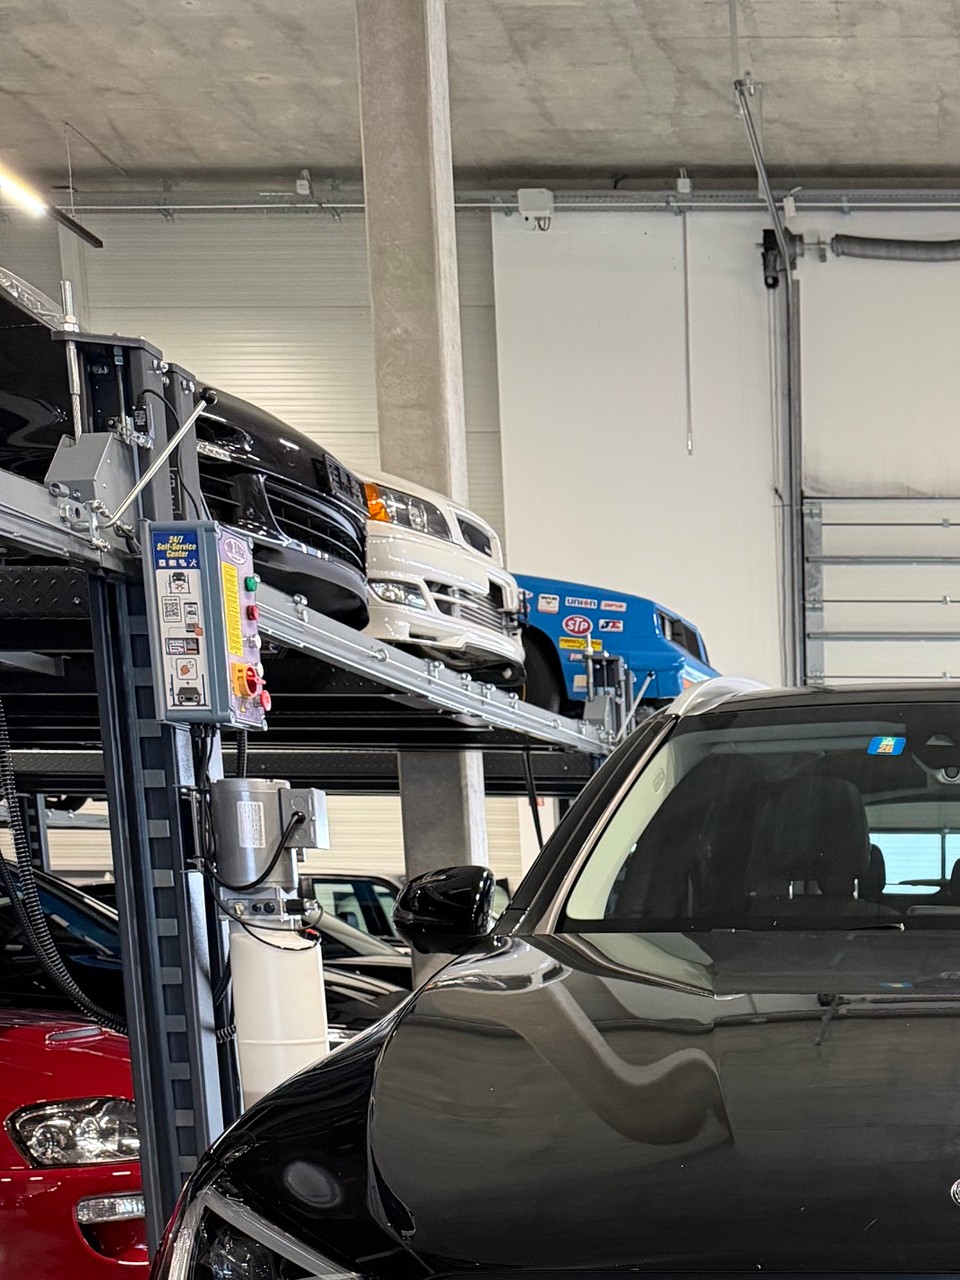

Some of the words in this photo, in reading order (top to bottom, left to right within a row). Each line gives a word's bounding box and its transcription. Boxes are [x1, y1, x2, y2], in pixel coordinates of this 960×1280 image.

[168, 535, 184, 543] 24/7
[156, 542, 197, 551] Self-Service
[166, 550, 189, 558] Center
[567, 616, 589, 633] STP
